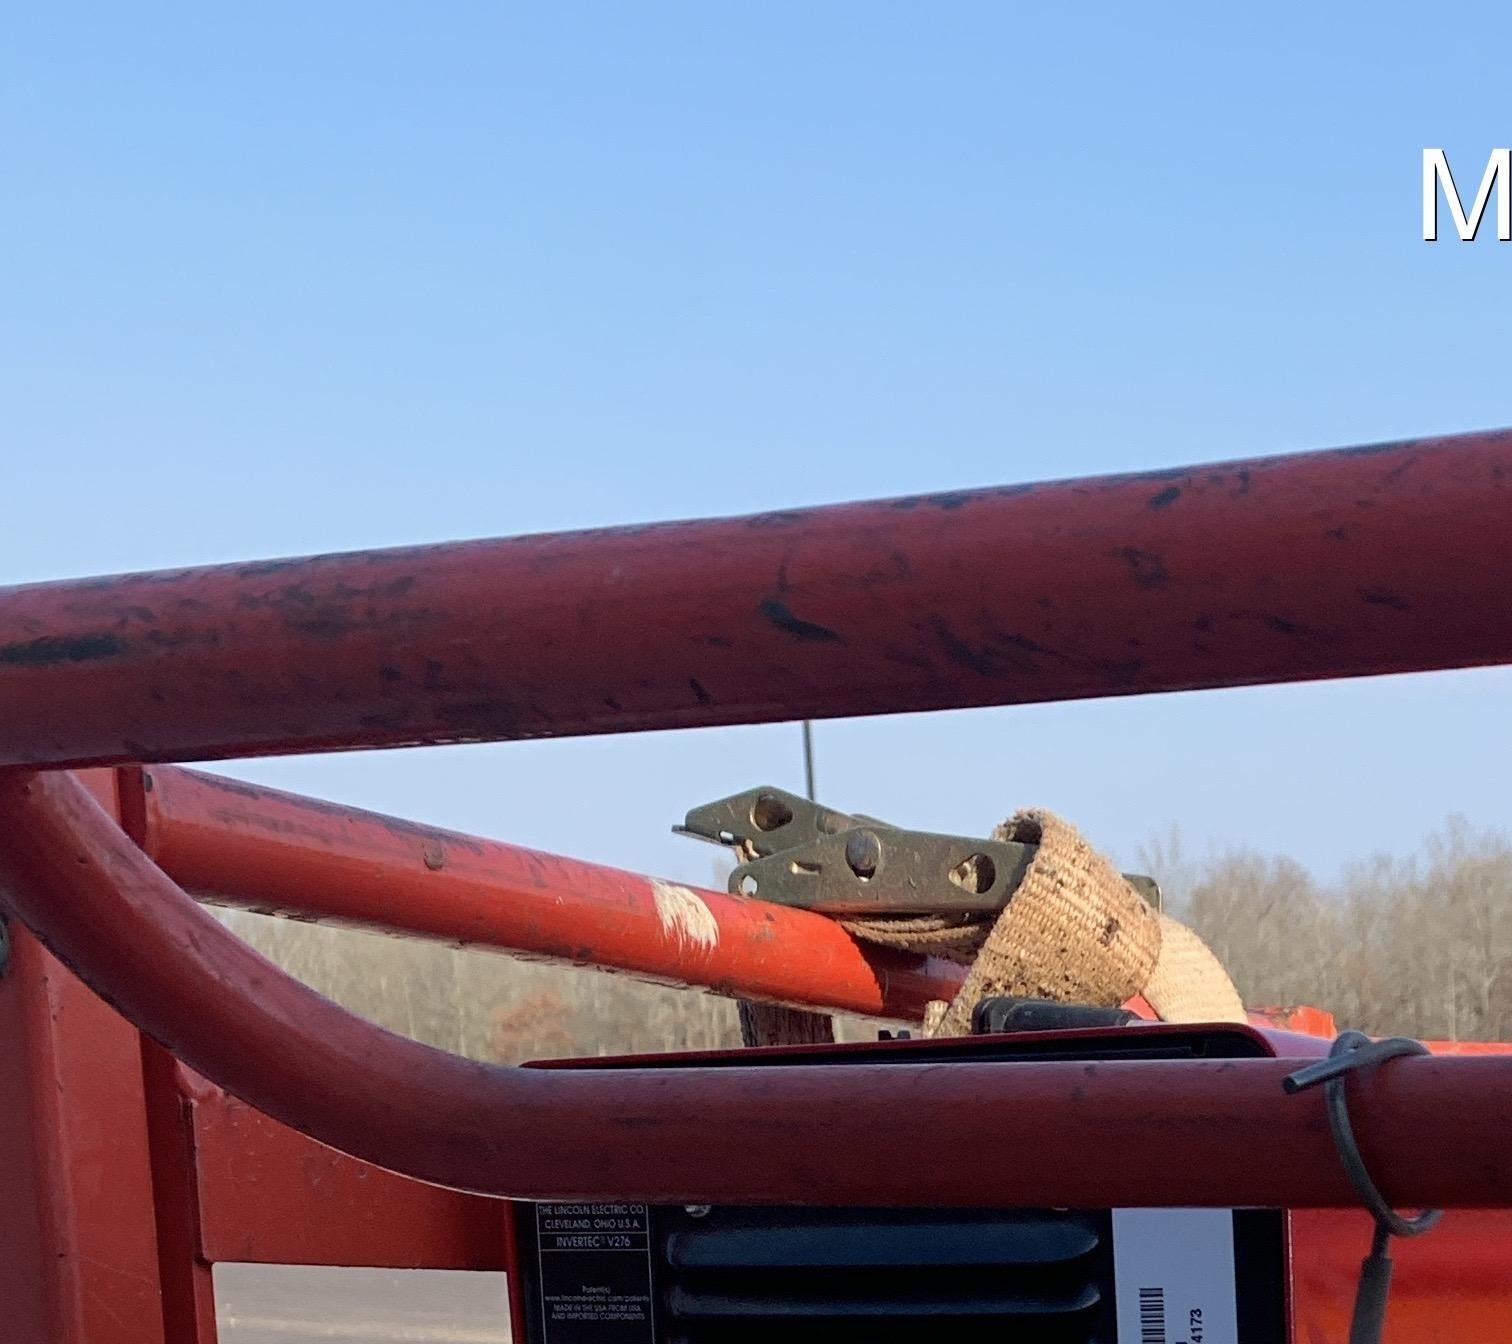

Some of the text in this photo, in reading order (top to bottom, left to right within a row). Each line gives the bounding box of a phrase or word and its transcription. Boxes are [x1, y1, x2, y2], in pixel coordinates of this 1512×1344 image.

[538, 1205, 552, 1215] THE
[554, 1205, 590, 1215] LINCOLN
[592, 1204, 628, 1215] ELECTRIC
[593, 1218, 616, 1229] OHIO
[606, 1235, 631, 1248] V276
